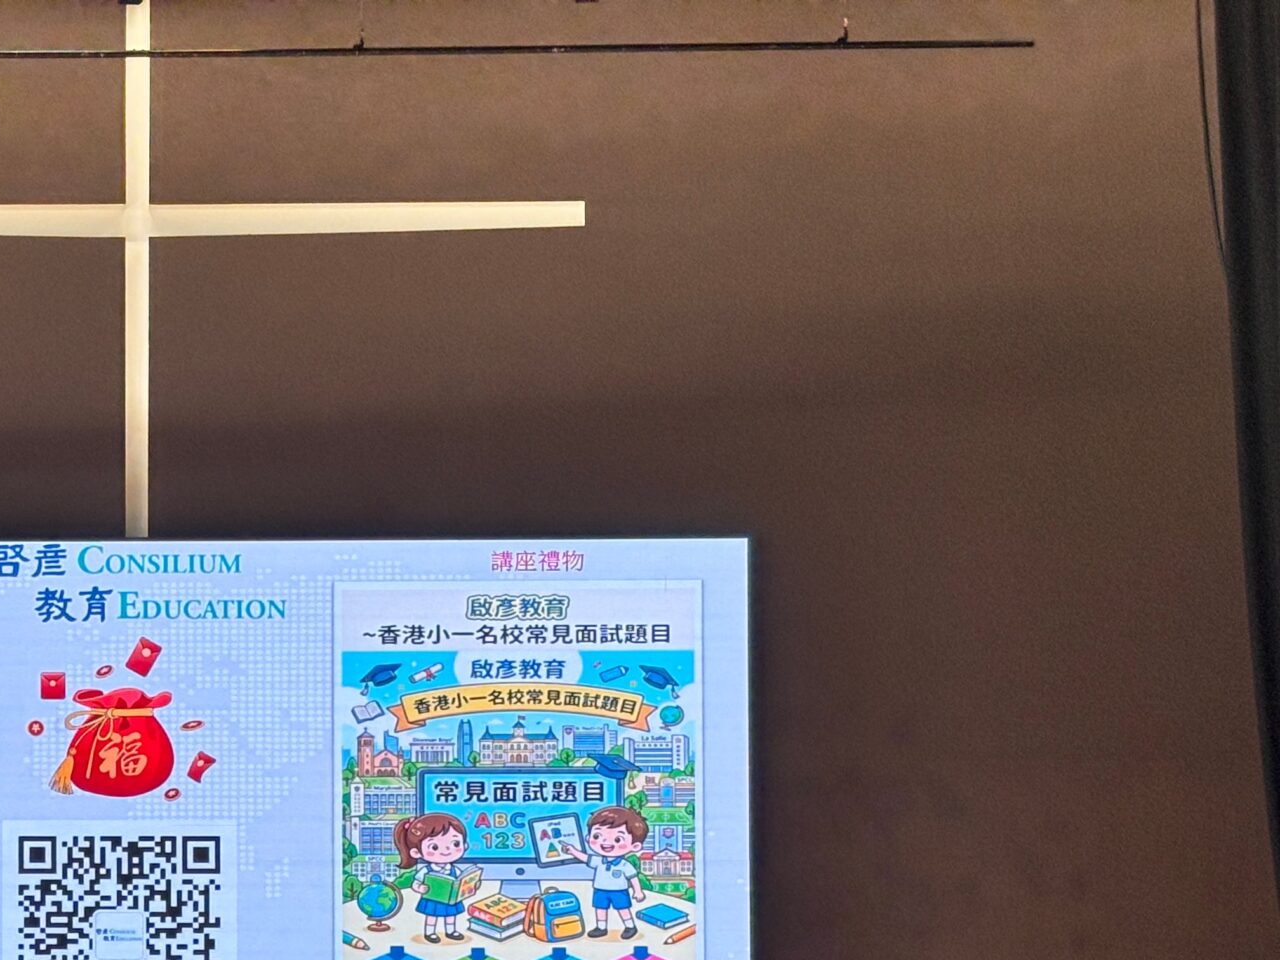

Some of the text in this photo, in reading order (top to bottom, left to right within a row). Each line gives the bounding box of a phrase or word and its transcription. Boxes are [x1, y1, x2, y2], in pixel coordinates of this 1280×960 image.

[77, 545, 242, 574] CONSILIUM
[491, 550, 585, 573] 講座禮物
[35, 586, 287, 623] 教育 EDUCATION
[414, 689, 638, 716] 香港小一名校常見面試題目
[99, 732, 149, 778] 福
[434, 780, 605, 804] 常見面試題目
[474, 812, 526, 829] ABC
[481, 832, 526, 850] 123
